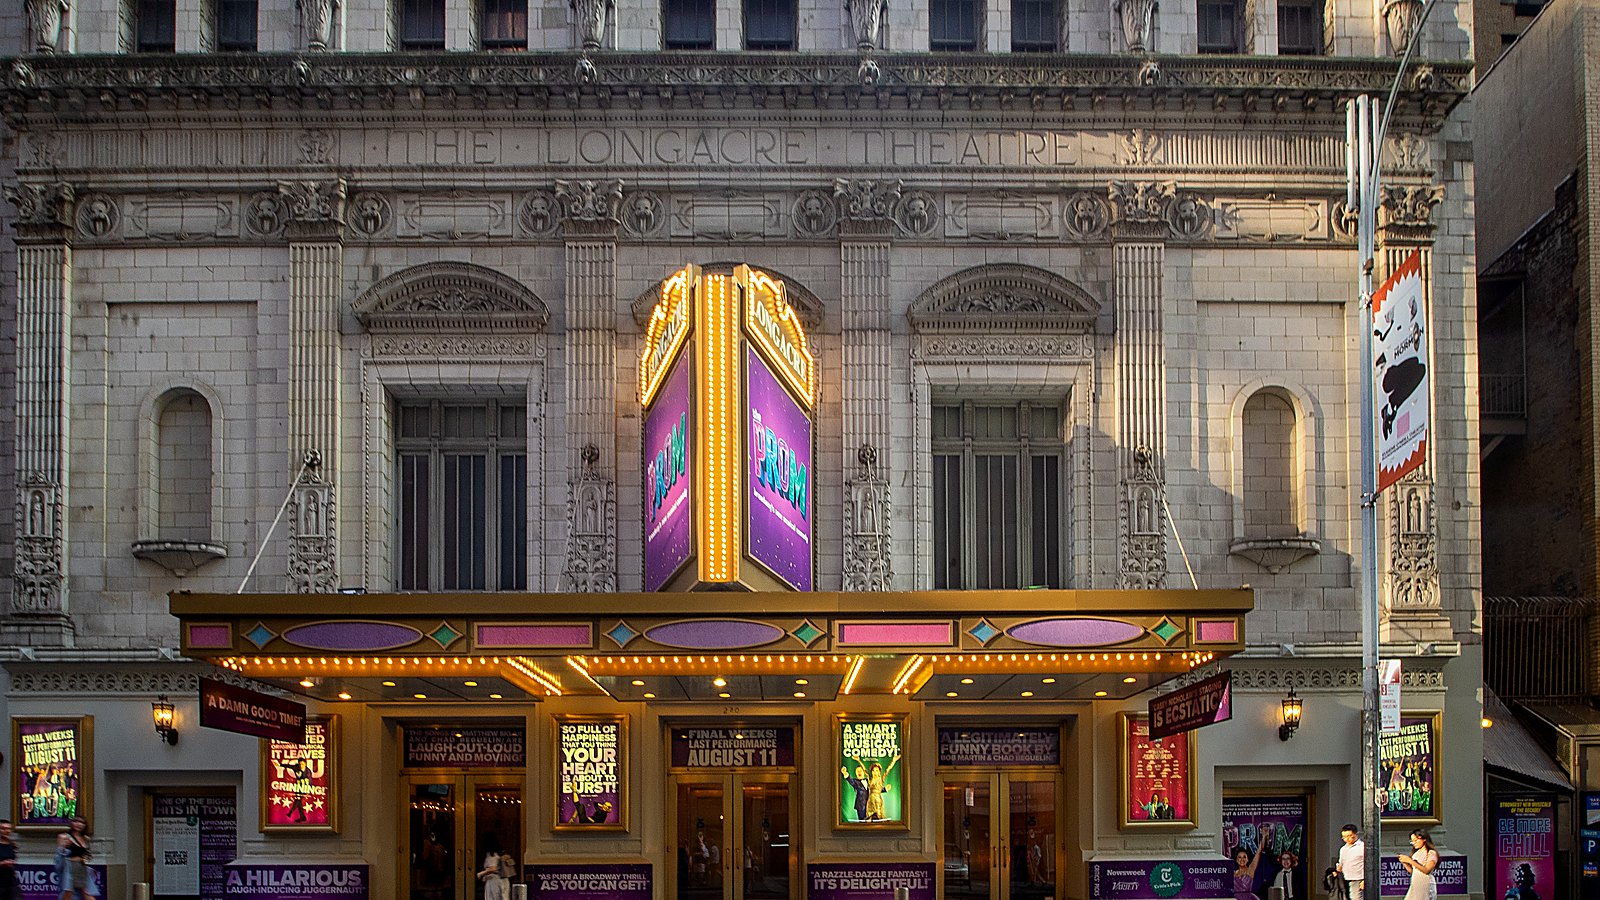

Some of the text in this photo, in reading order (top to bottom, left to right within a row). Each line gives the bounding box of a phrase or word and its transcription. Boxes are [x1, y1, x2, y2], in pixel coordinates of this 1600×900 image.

[392, 129, 1078, 165] THE LONGACRE THEATRE
[1394, 326, 1424, 360] MORMN
[648, 412, 686, 521] PROM
[752, 419, 807, 519] PROM
[1200, 681, 1222, 695] STAGING
[218, 697, 249, 716] DAMN
[251, 705, 278, 721] GOOD
[1153, 710, 1163, 728] IS
[578, 726, 602, 734] FULL
[602, 726, 616, 734] OF
[688, 730, 777, 739] FINAL WEEKS!
[1400, 724, 1428, 734] WEEKS!
[22, 730, 74, 744] FINAL WEEKS!
[688, 740, 777, 748] LAST PERFORMANCE
[844, 740, 898, 748] MUSICAL
[954, 732, 1054, 744] LEGITIMATELY
[1380, 738, 1392, 746] LAST
[1392, 732, 1428, 745] PERFORMANCE
[24, 739, 75, 752] LAST PERFORMANCE
[409, 743, 522, 753] LAUGH-OUT-LOUD
[941, 744, 1052, 754] FUNNY BOOK BY
[1380, 740, 1430, 760] AUGUST 11
[25, 747, 76, 766] AUGUST 11
[271, 750, 326, 759] IT LEAVES
[409, 753, 447, 762] FUNNY
[448, 753, 474, 762] AND
[562, 748, 616, 762] YOUR
[688, 748, 777, 766] AUGUST 11
[562, 762, 616, 774] HEART
[22, 794, 77, 820] PROM
[156, 806, 236, 815] HITS IN TOWN
[1498, 818, 1551, 833] BE MORE
[1223, 822, 1302, 858] PROM
[1498, 833, 1550, 857] CHILL
[1588, 840, 1596, 852] P
[246, 870, 361, 886] HILARIOUS
[540, 880, 559, 890] AS
[560, 880, 588, 890] YOU
[589, 880, 616, 890] CAN
[814, 879, 837, 890] IT'S
[1112, 882, 1139, 891] VARIETY
